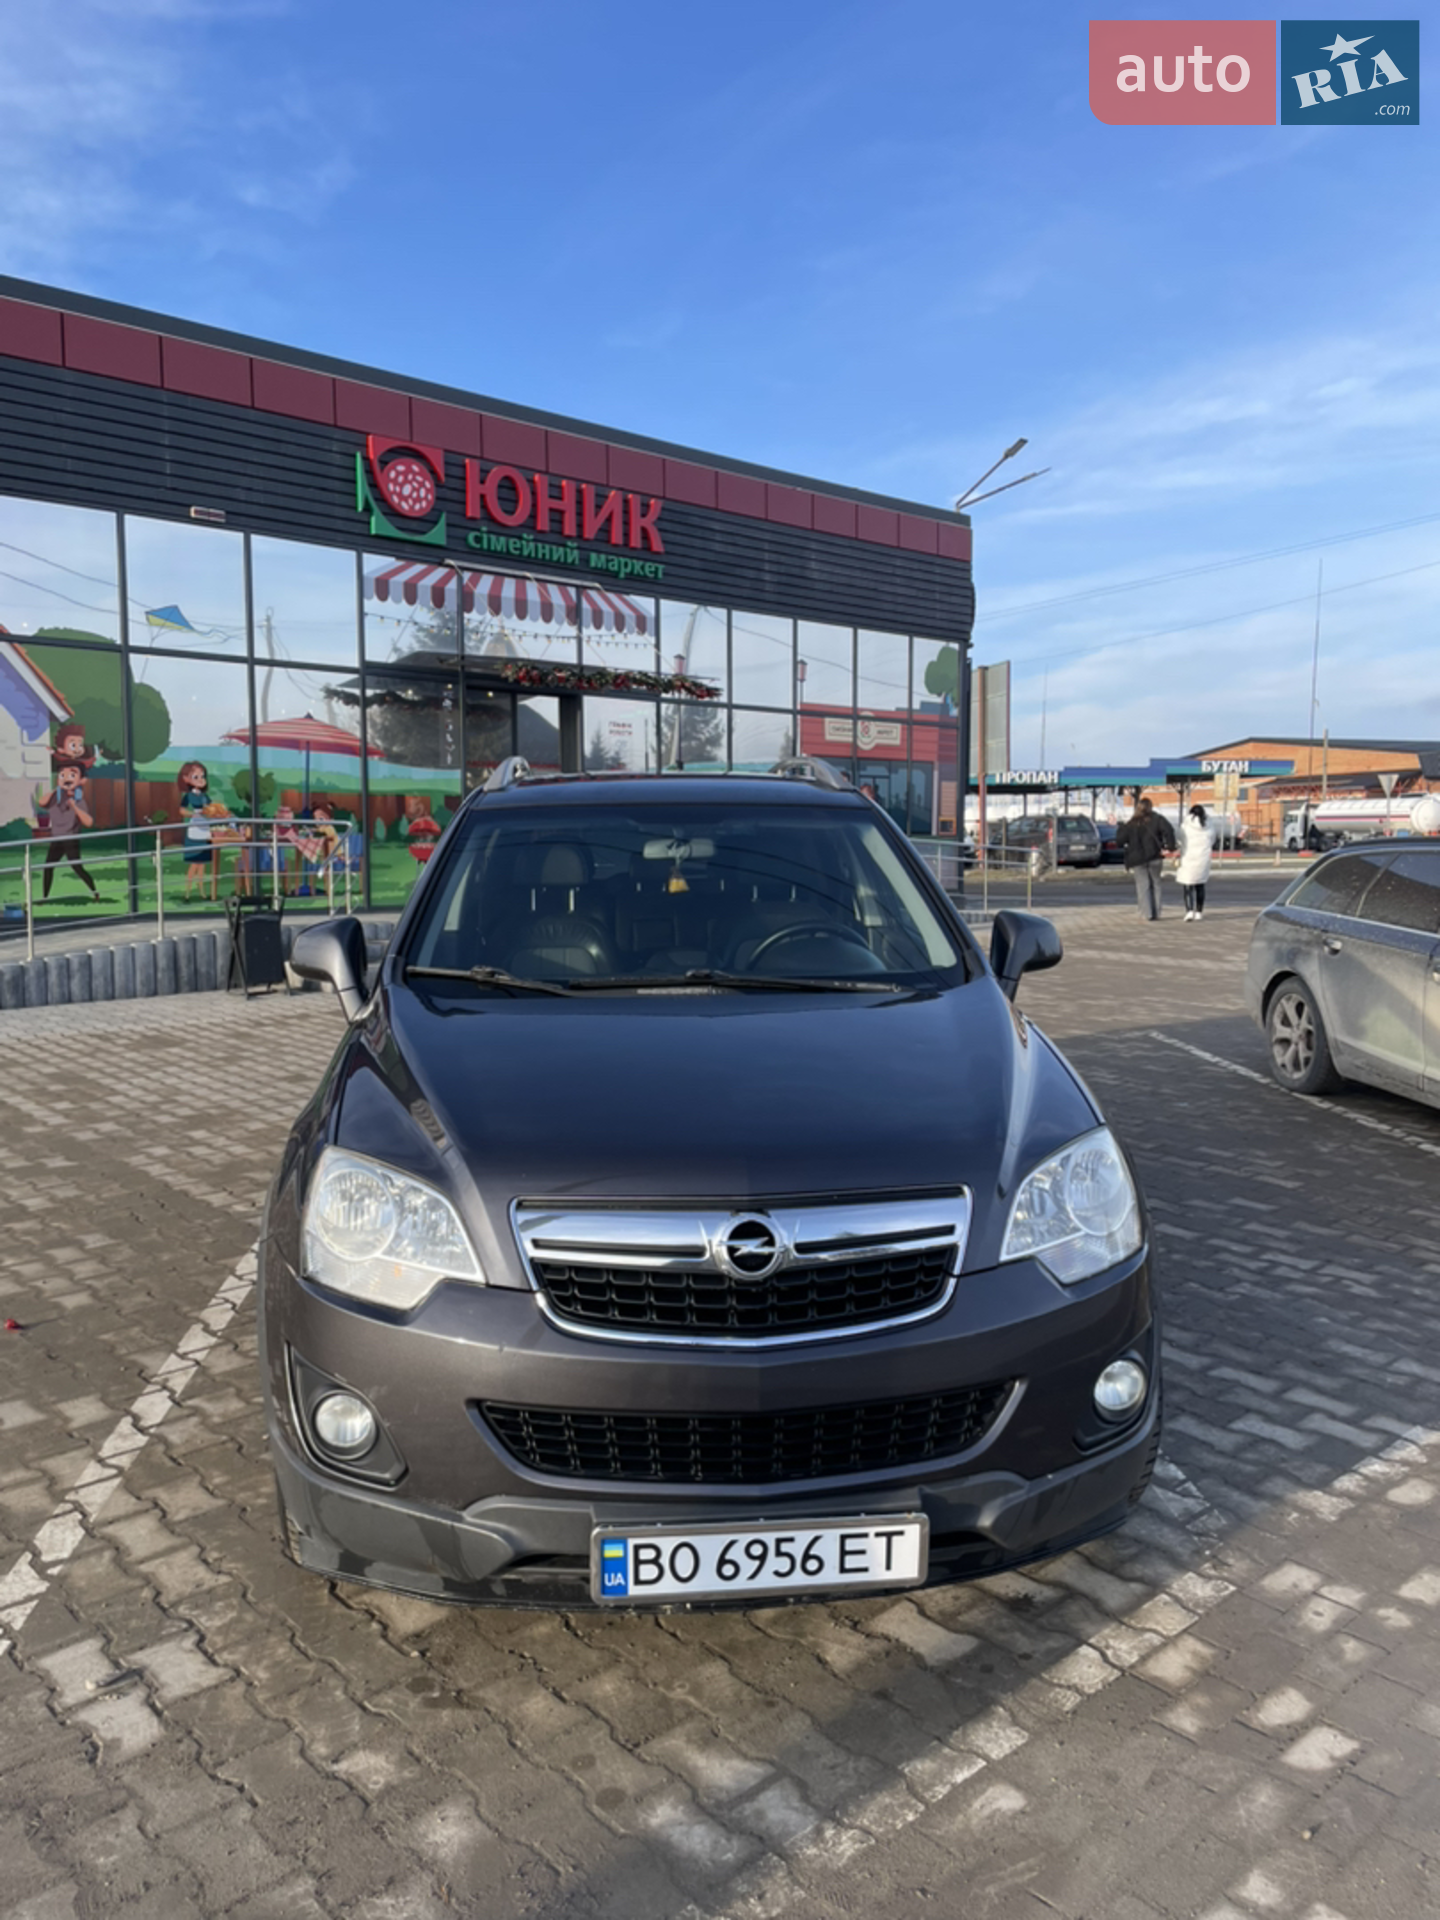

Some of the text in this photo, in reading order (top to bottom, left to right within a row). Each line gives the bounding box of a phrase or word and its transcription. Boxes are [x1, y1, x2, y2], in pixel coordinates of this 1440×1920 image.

[464, 457, 665, 553] ЮНИК
[466, 526, 666, 579] сімейний маркет
[995, 770, 1059, 784] ПРОПАН
[1201, 760, 1249, 773] БУТАН
[632, 1530, 905, 1586] BO 6956 ET
[604, 1572, 626, 1587] UA
